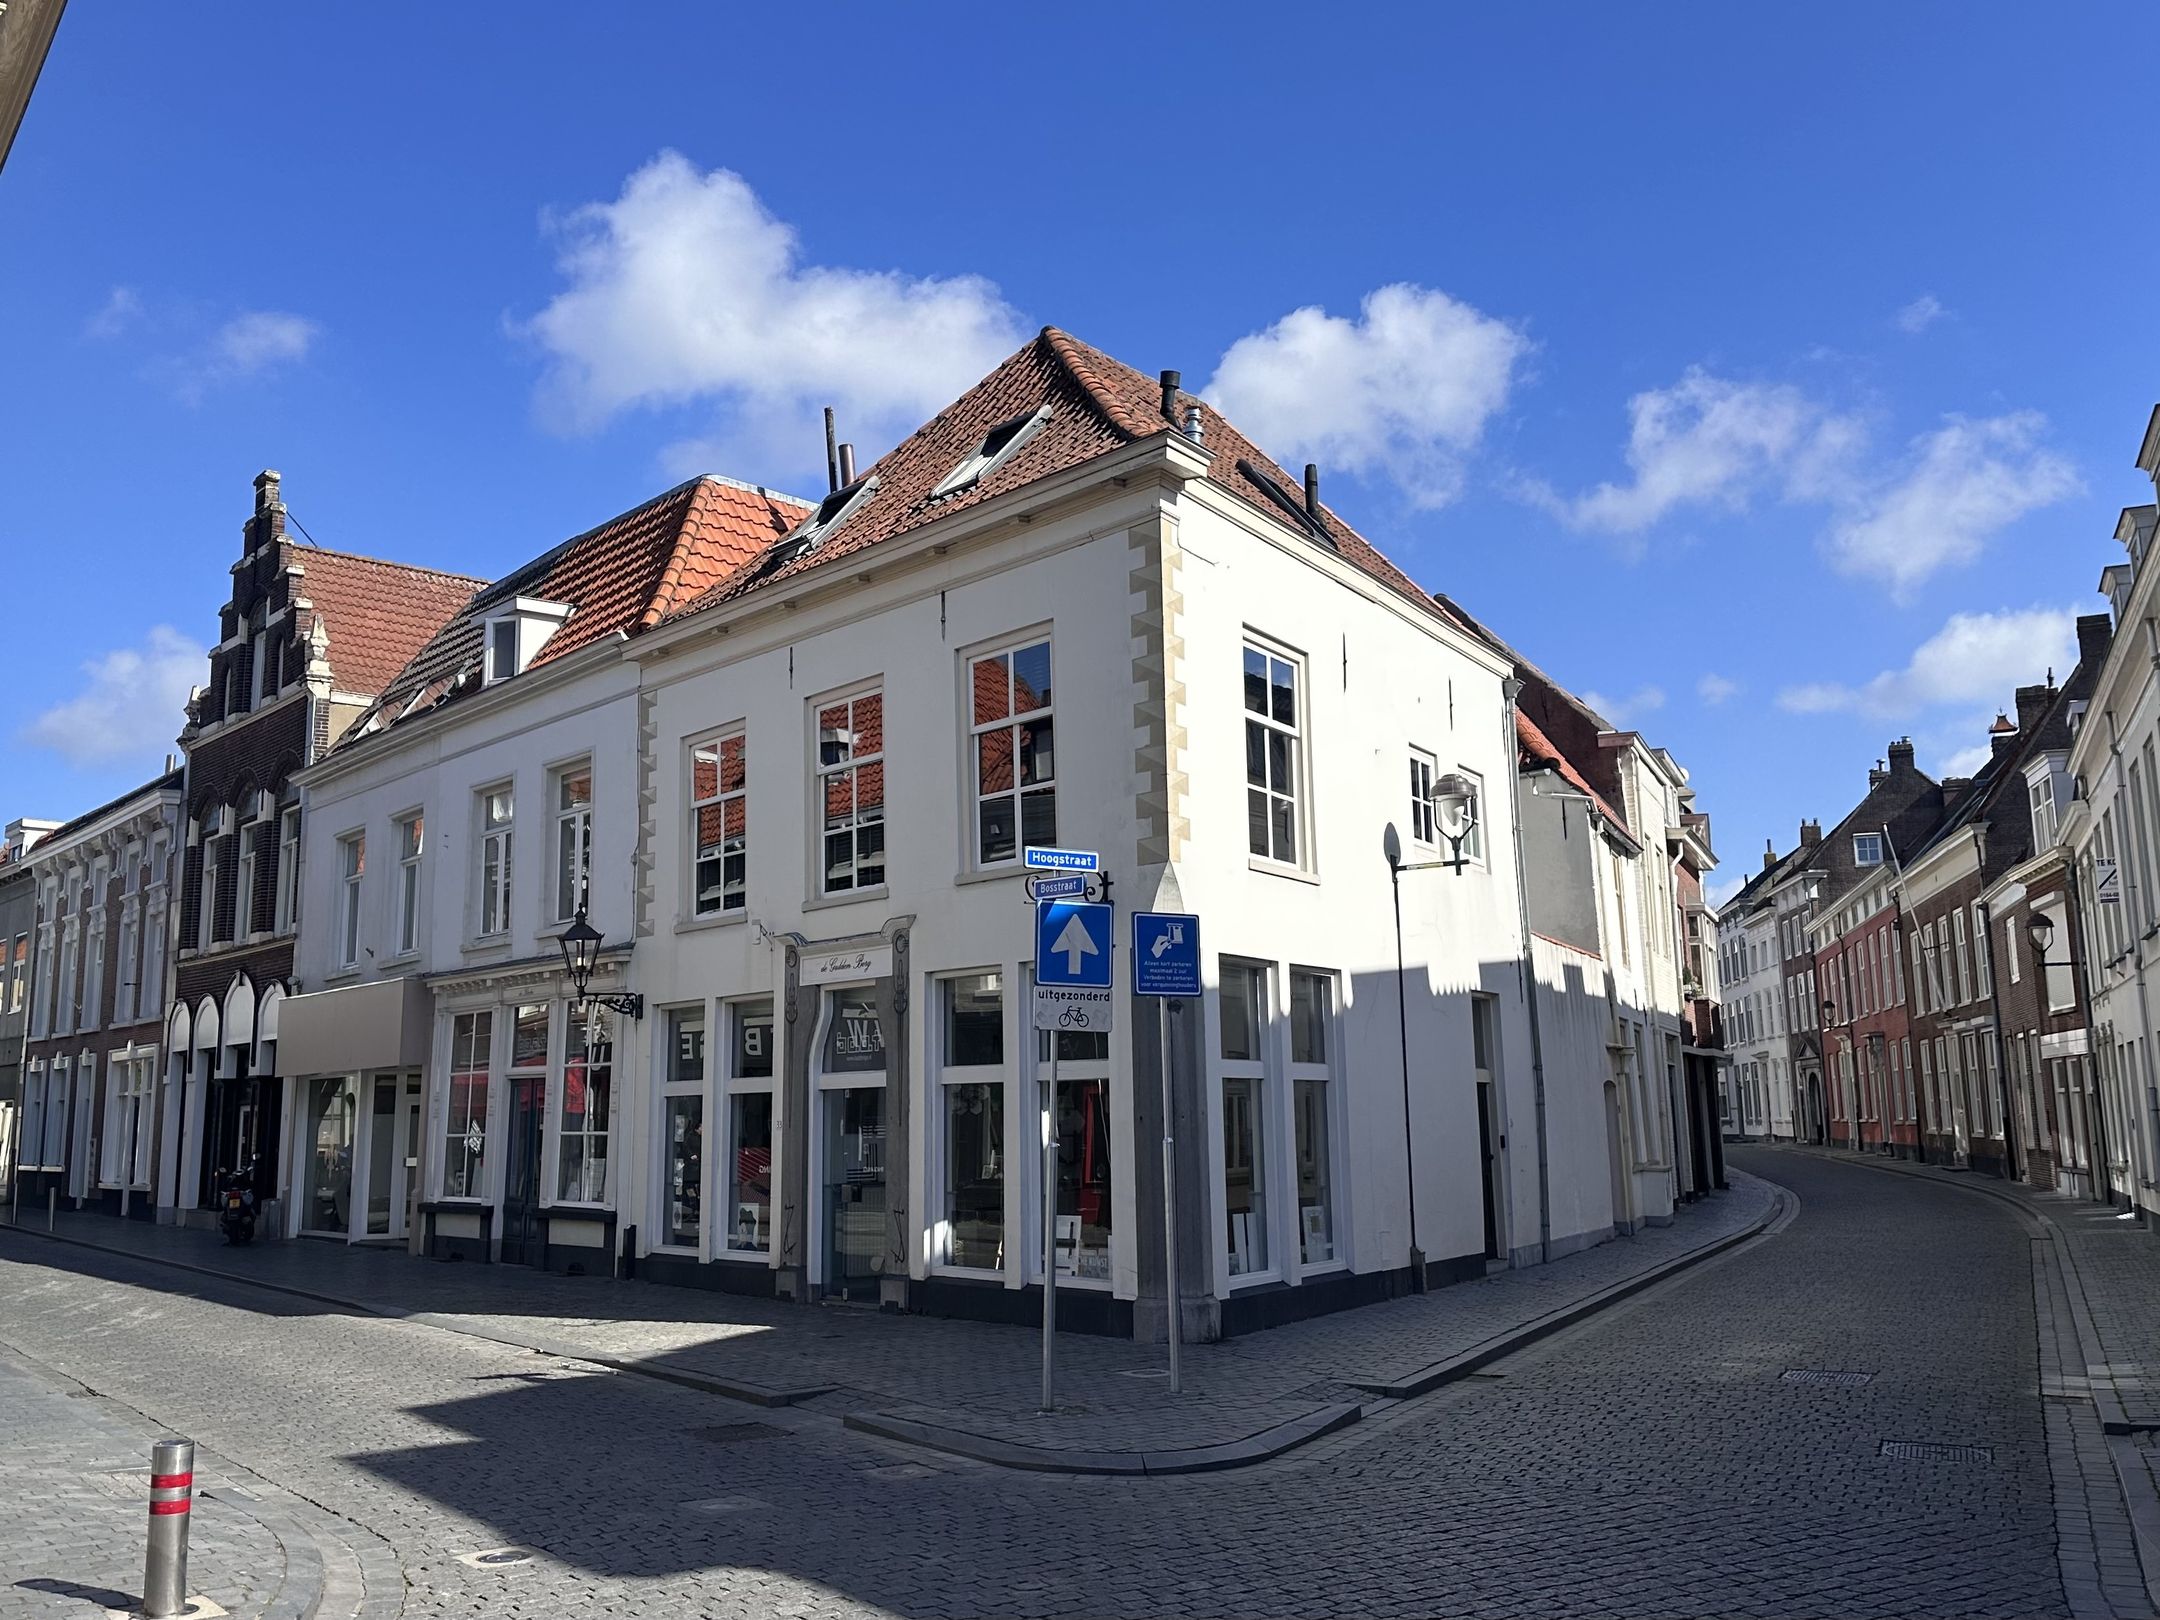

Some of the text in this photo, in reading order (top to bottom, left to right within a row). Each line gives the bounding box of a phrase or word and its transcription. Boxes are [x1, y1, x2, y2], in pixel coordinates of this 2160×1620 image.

[1032, 851, 1092, 867] Hoogstraat
[1040, 881, 1077, 893] Bosstraat
[1038, 989, 1110, 1003] uitgezonderd
